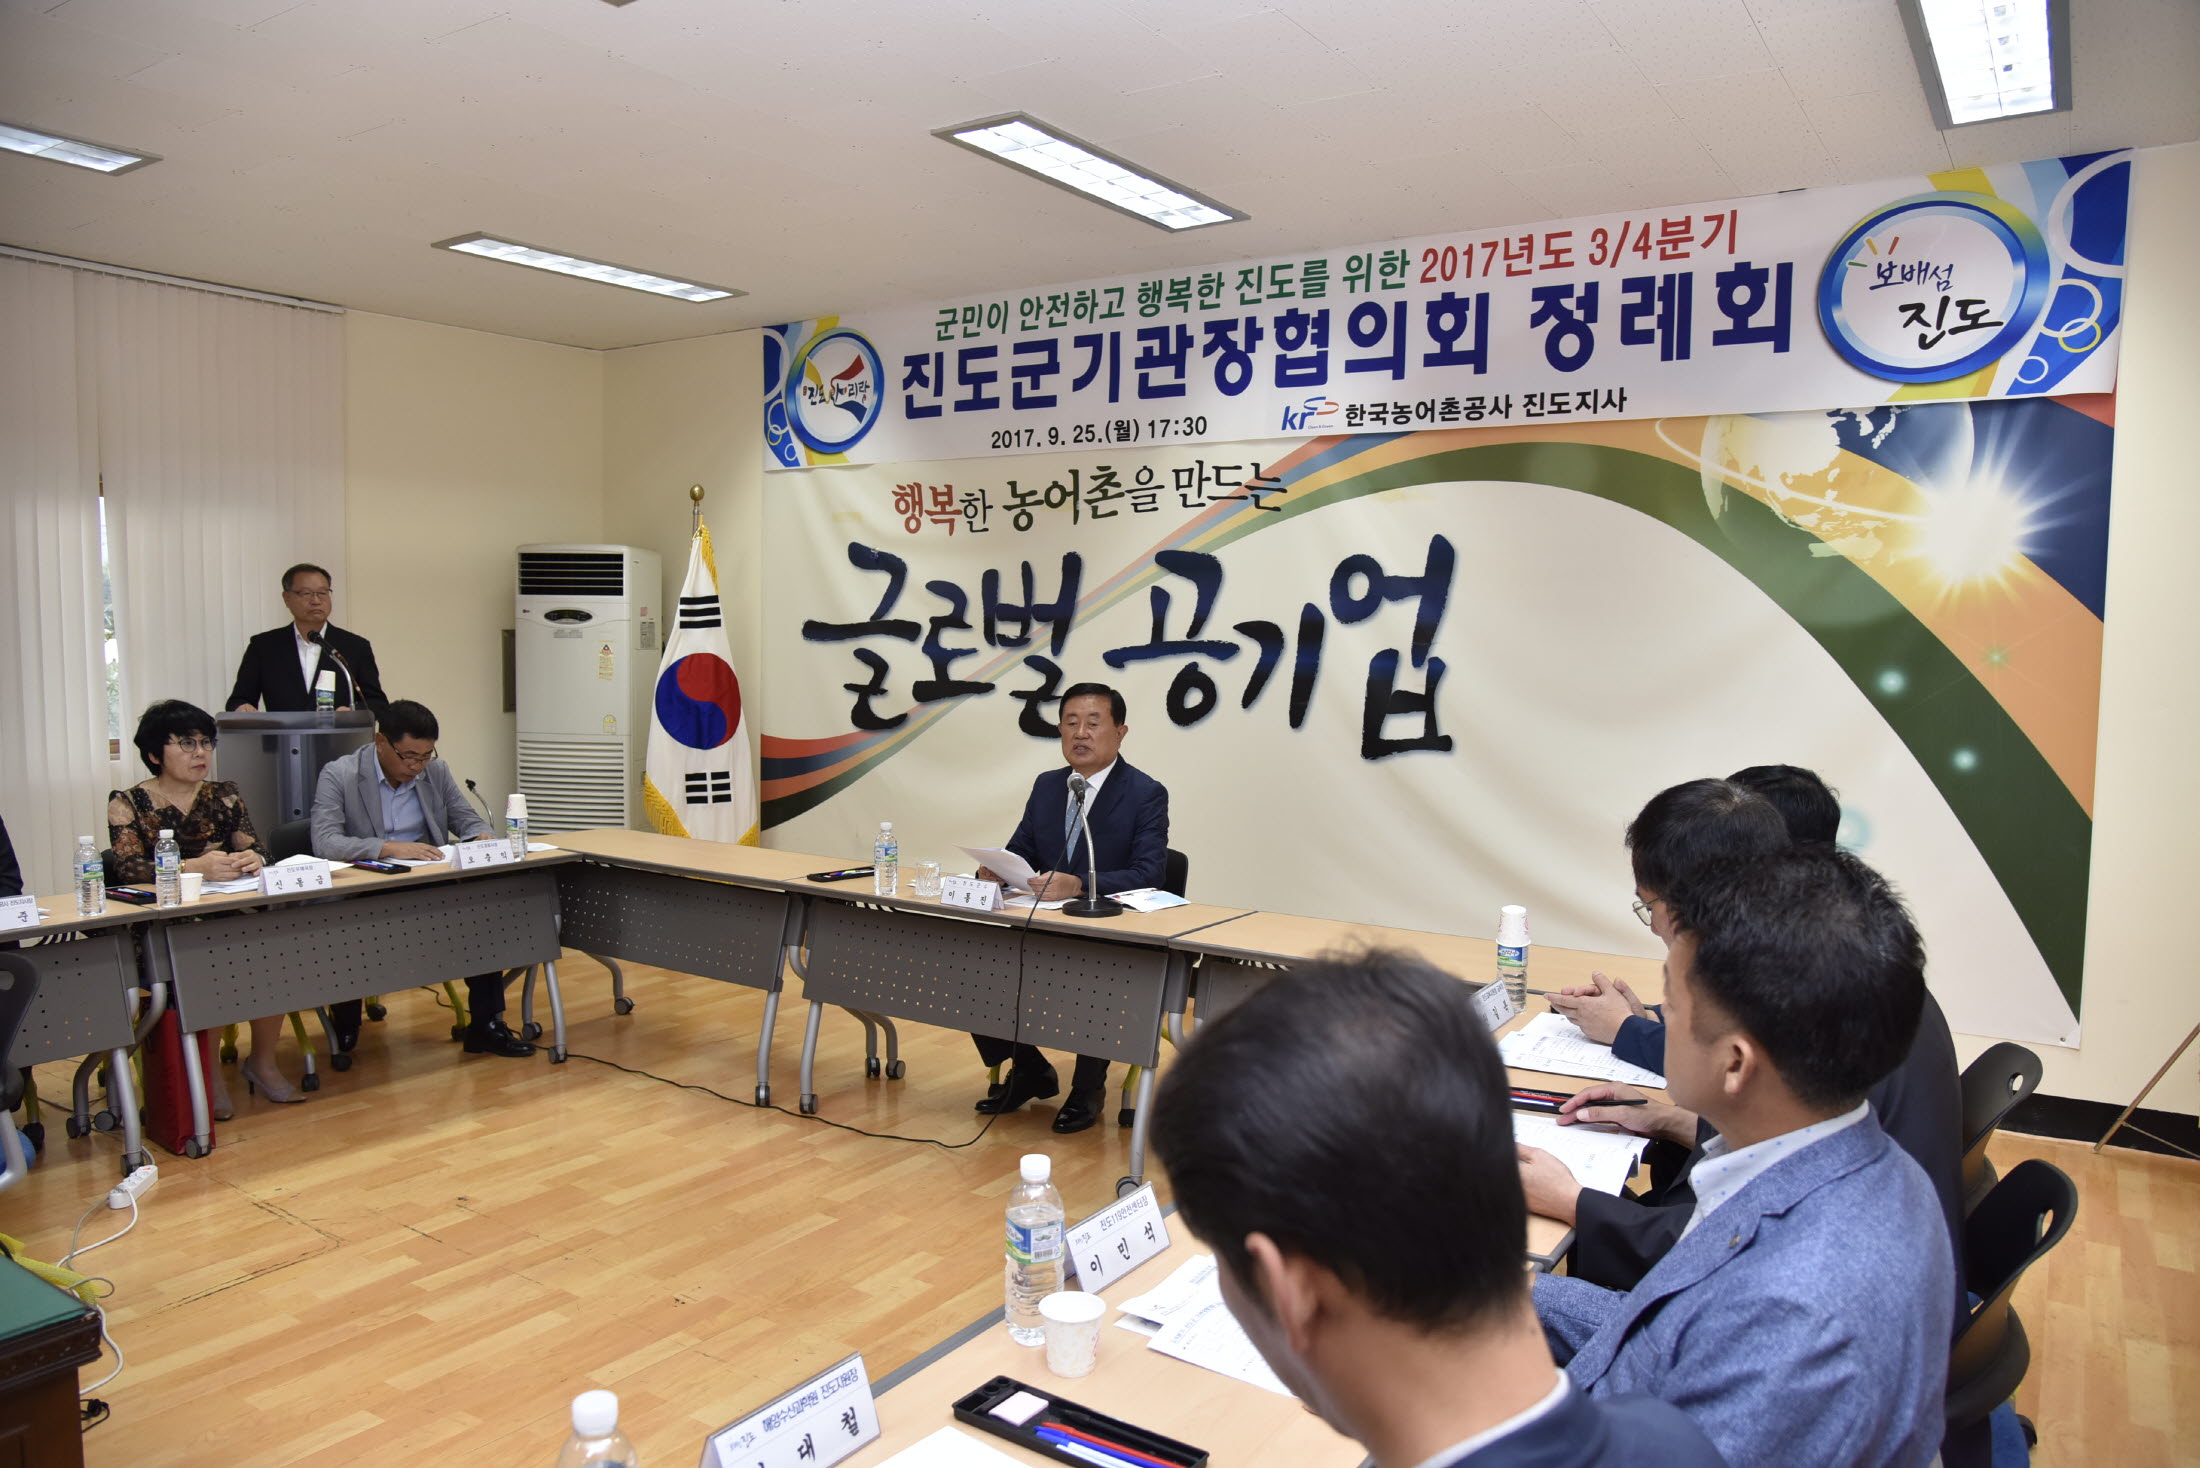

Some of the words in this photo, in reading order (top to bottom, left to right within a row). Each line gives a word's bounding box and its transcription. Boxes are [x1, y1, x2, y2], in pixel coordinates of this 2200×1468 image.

[935, 300, 1009, 342] 군민이
[1018, 284, 1126, 330] 안전하고
[1136, 271, 1226, 319] 행복한
[1234, 257, 1331, 306] 진도를
[1342, 247, 1411, 294] 위한
[1420, 227, 1576, 285] 2017년도
[1588, 208, 1740, 269] 3/4분기
[1868, 260, 1954, 294] 보배섬
[901, 291, 1490, 420] 진도군기관장협의회
[1529, 261, 1794, 373] 정례회
[1898, 294, 2005, 351] 진도
[991, 428, 1043, 449] 2017.
[1147, 415, 1208, 439] 17:30
[1345, 391, 1513, 428] 한국농어촌공사
[1522, 386, 1628, 419] 진도지사
[892, 481, 993, 537] 행복한
[1002, 464, 1166, 533] 농어촌을
[1172, 459, 1289, 512] 만드는
[802, 541, 1082, 740] 글로벌
[1102, 533, 1457, 761] 공기업
[796, 1432, 816, 1462] 대
